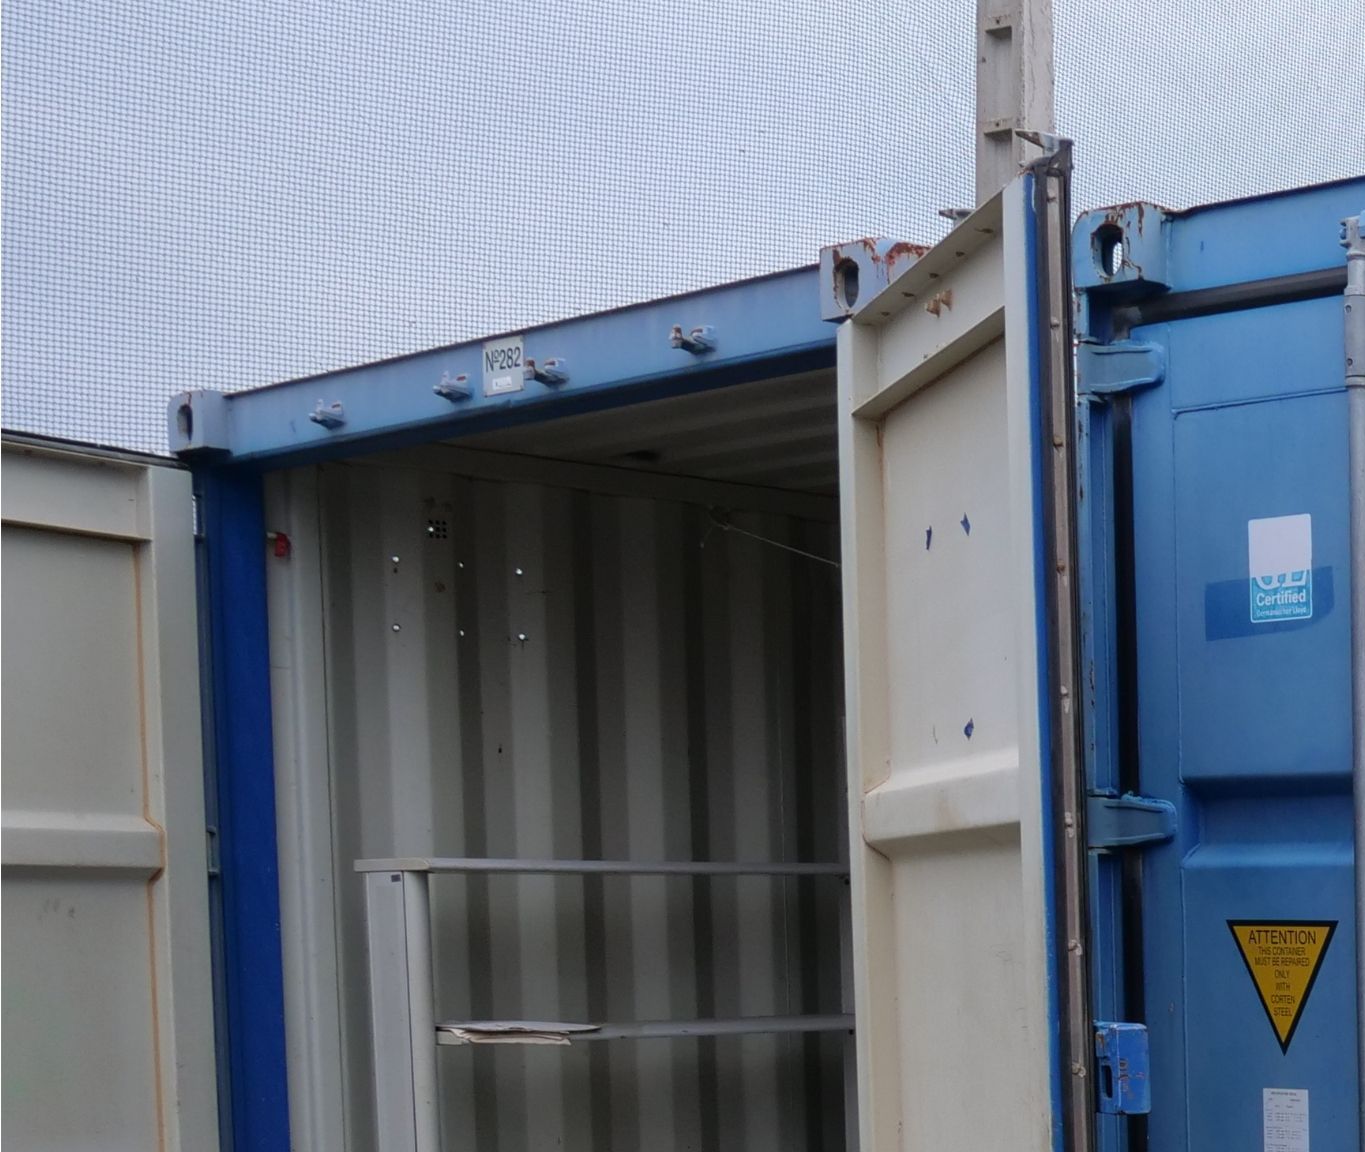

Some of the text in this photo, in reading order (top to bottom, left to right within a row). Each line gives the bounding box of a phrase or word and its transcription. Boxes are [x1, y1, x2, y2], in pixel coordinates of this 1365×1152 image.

[1256, 589, 1306, 606] Certified
[1248, 929, 1317, 945] ATTENTION
[1258, 946, 1306, 956] THIS CONTAINER
[1254, 957, 1310, 967] MUST BE REPAIRED
[1274, 969, 1291, 979] ONLY
[1275, 981, 1291, 992] WITH
[1271, 994, 1296, 1004] CORTEN
[1273, 1006, 1293, 1017] STEEL
